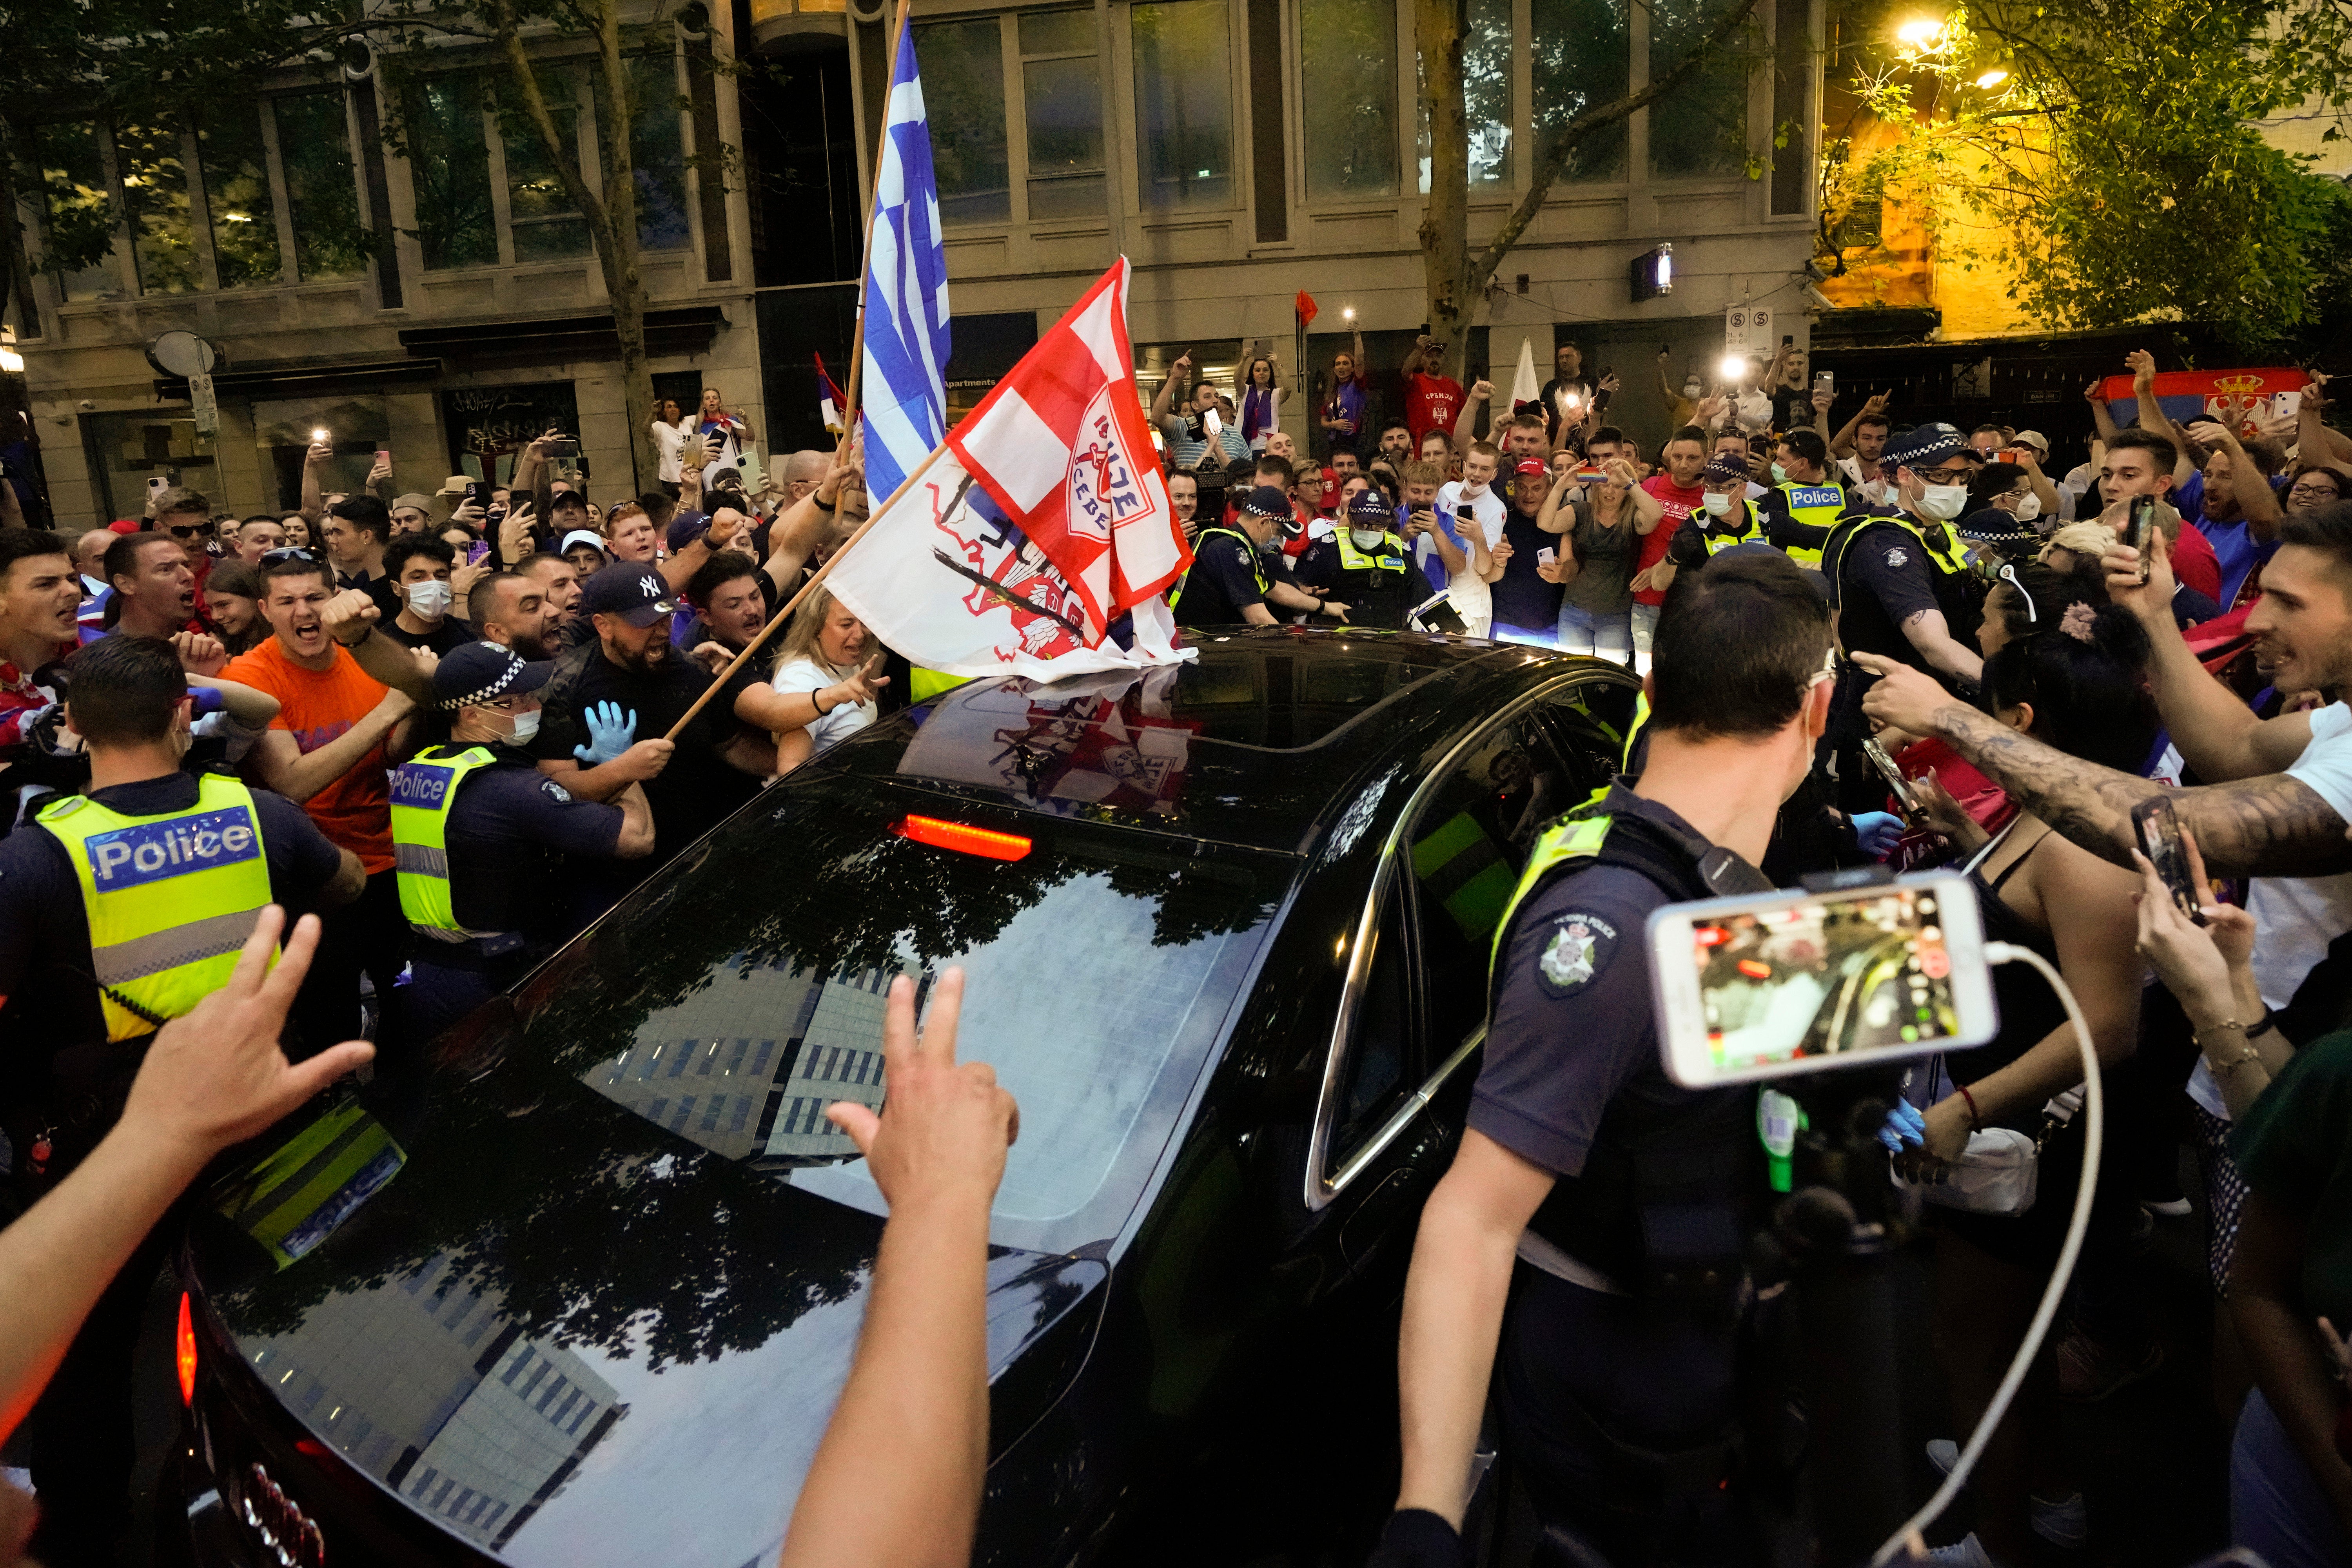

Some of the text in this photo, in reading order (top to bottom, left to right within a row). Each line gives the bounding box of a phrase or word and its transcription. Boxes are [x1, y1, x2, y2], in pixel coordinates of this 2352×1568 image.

[945, 379, 996, 389] Apartments
[1792, 491, 1839, 505] Police
[392, 770, 444, 800] Police
[95, 825, 251, 880] Police
